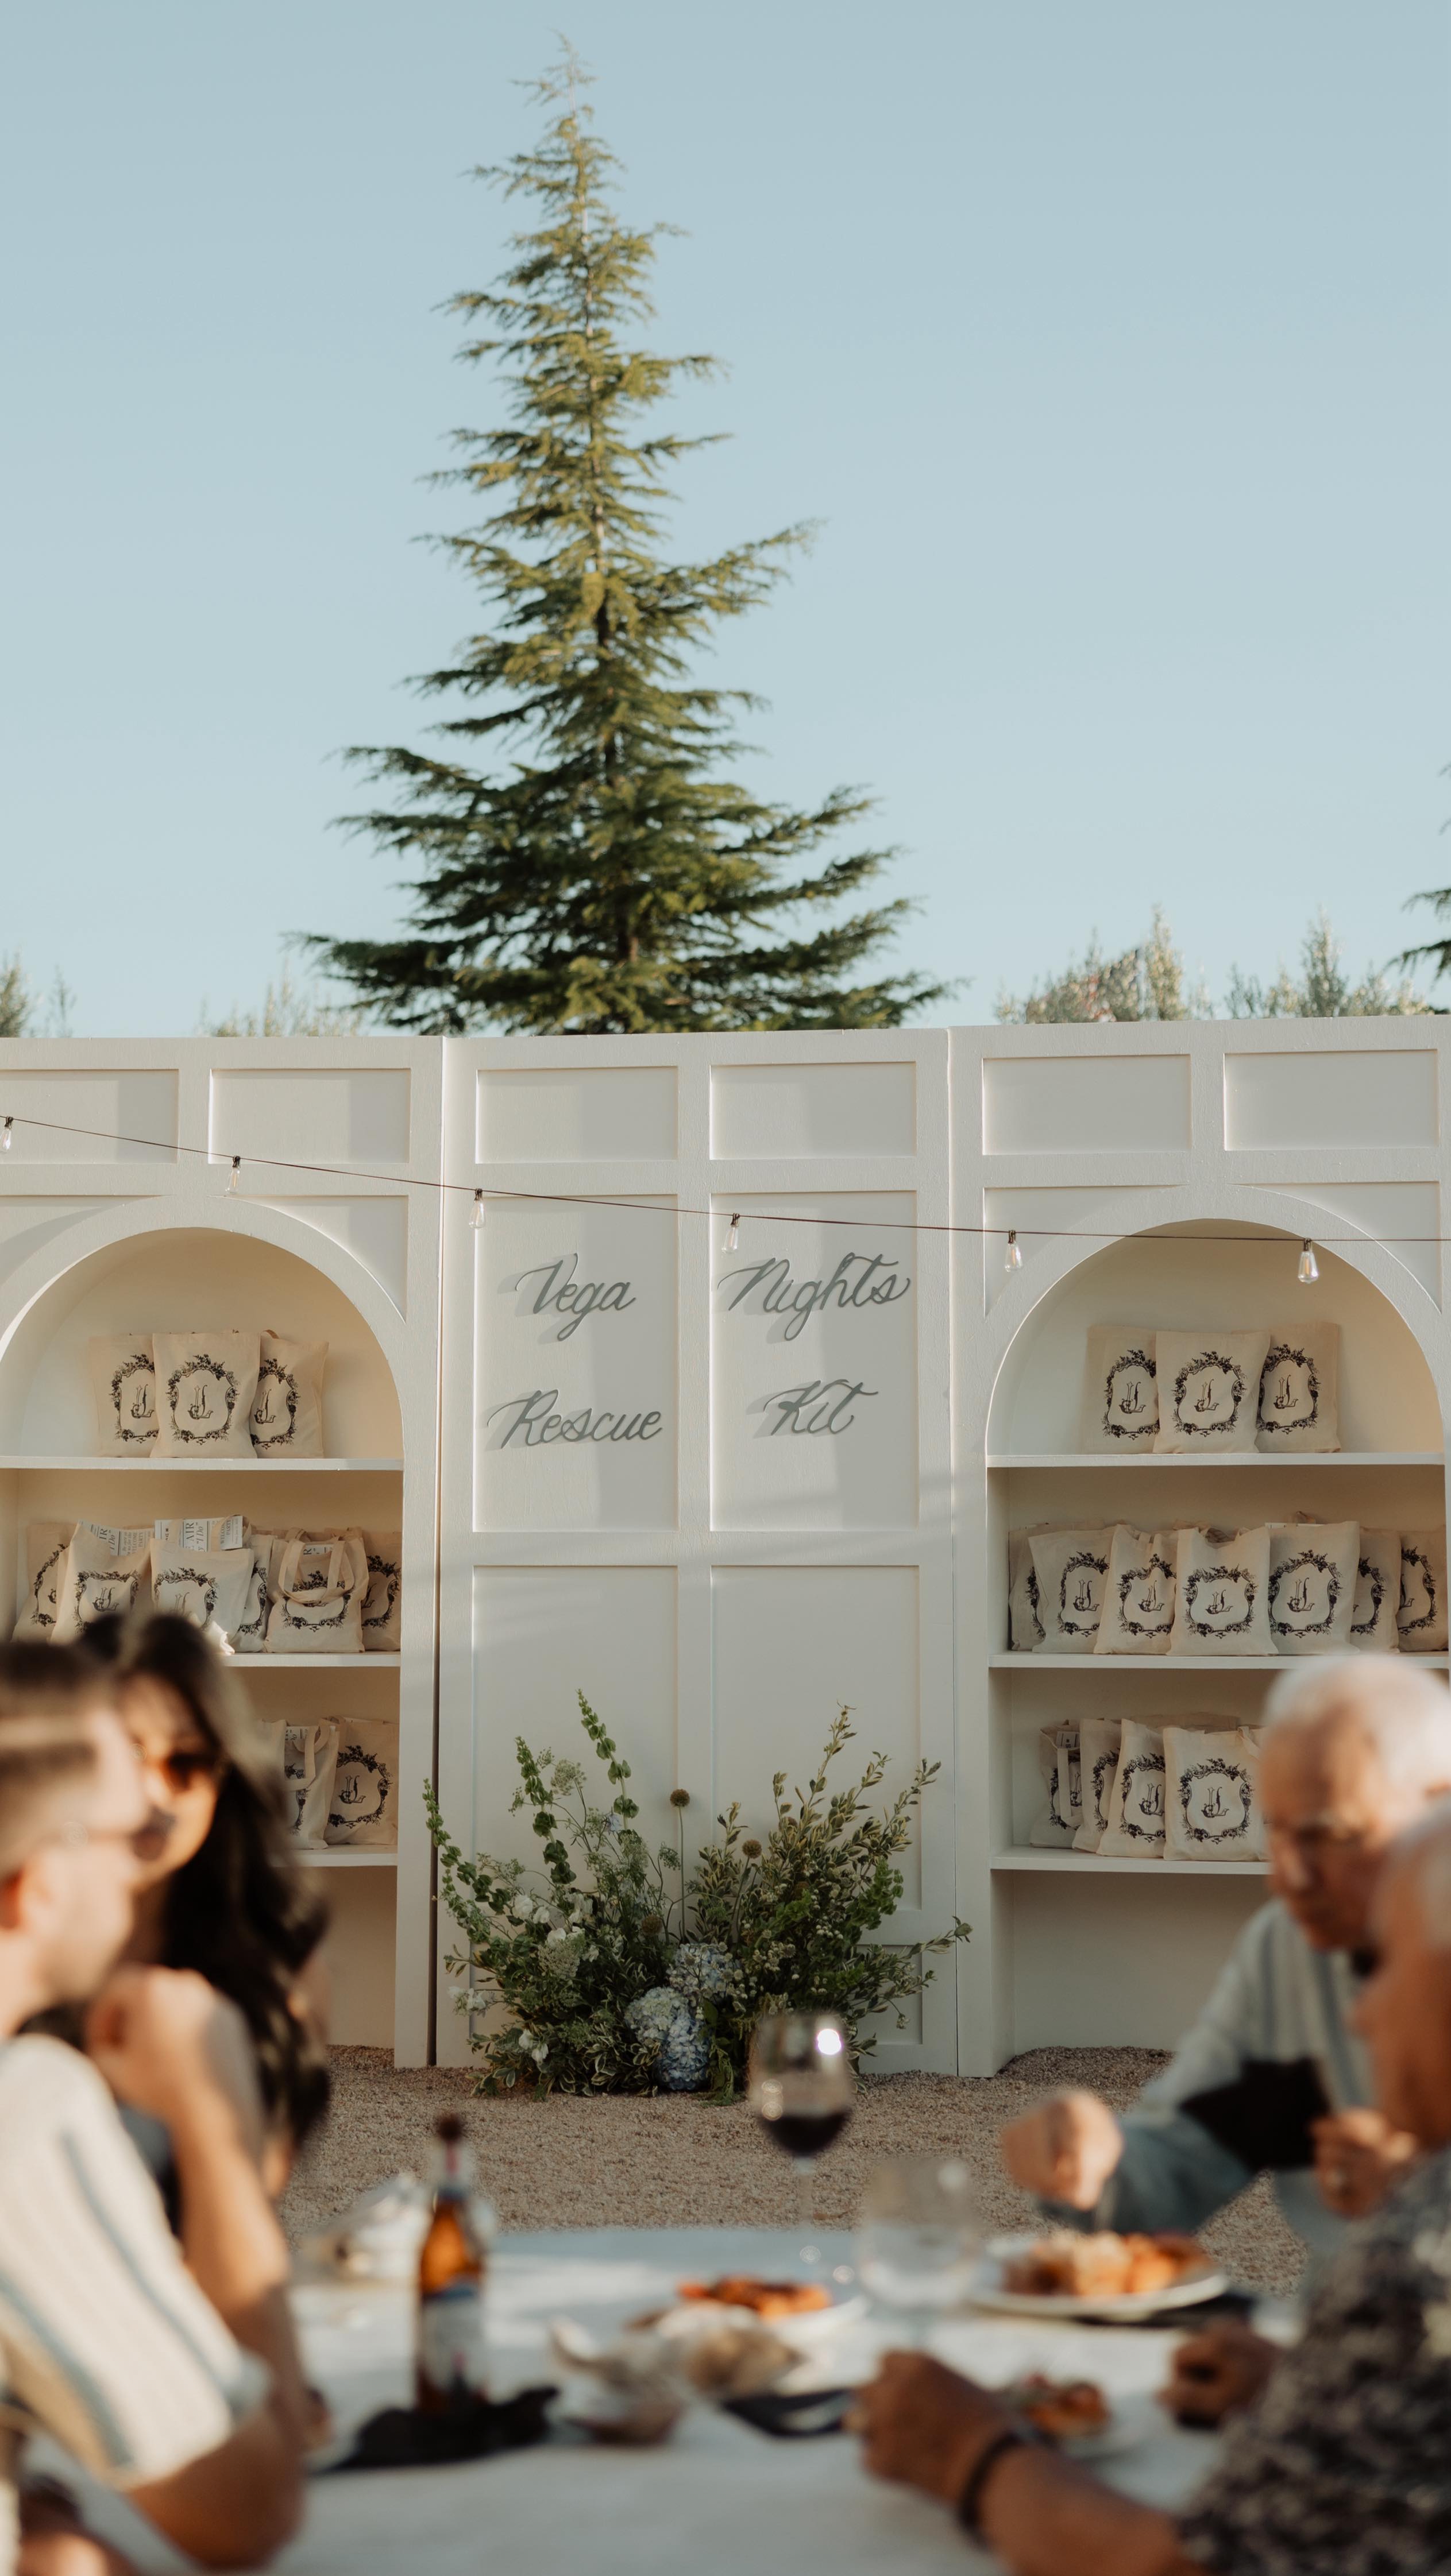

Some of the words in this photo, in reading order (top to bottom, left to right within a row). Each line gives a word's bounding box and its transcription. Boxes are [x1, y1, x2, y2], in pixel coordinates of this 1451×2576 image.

[515, 1252, 636, 1341] Vega
[717, 1252, 911, 1341] Nights
[487, 1389, 662, 1449] Rescue
[763, 1379, 879, 1436] Kit
[186, 1522, 194, 1542] AIR
